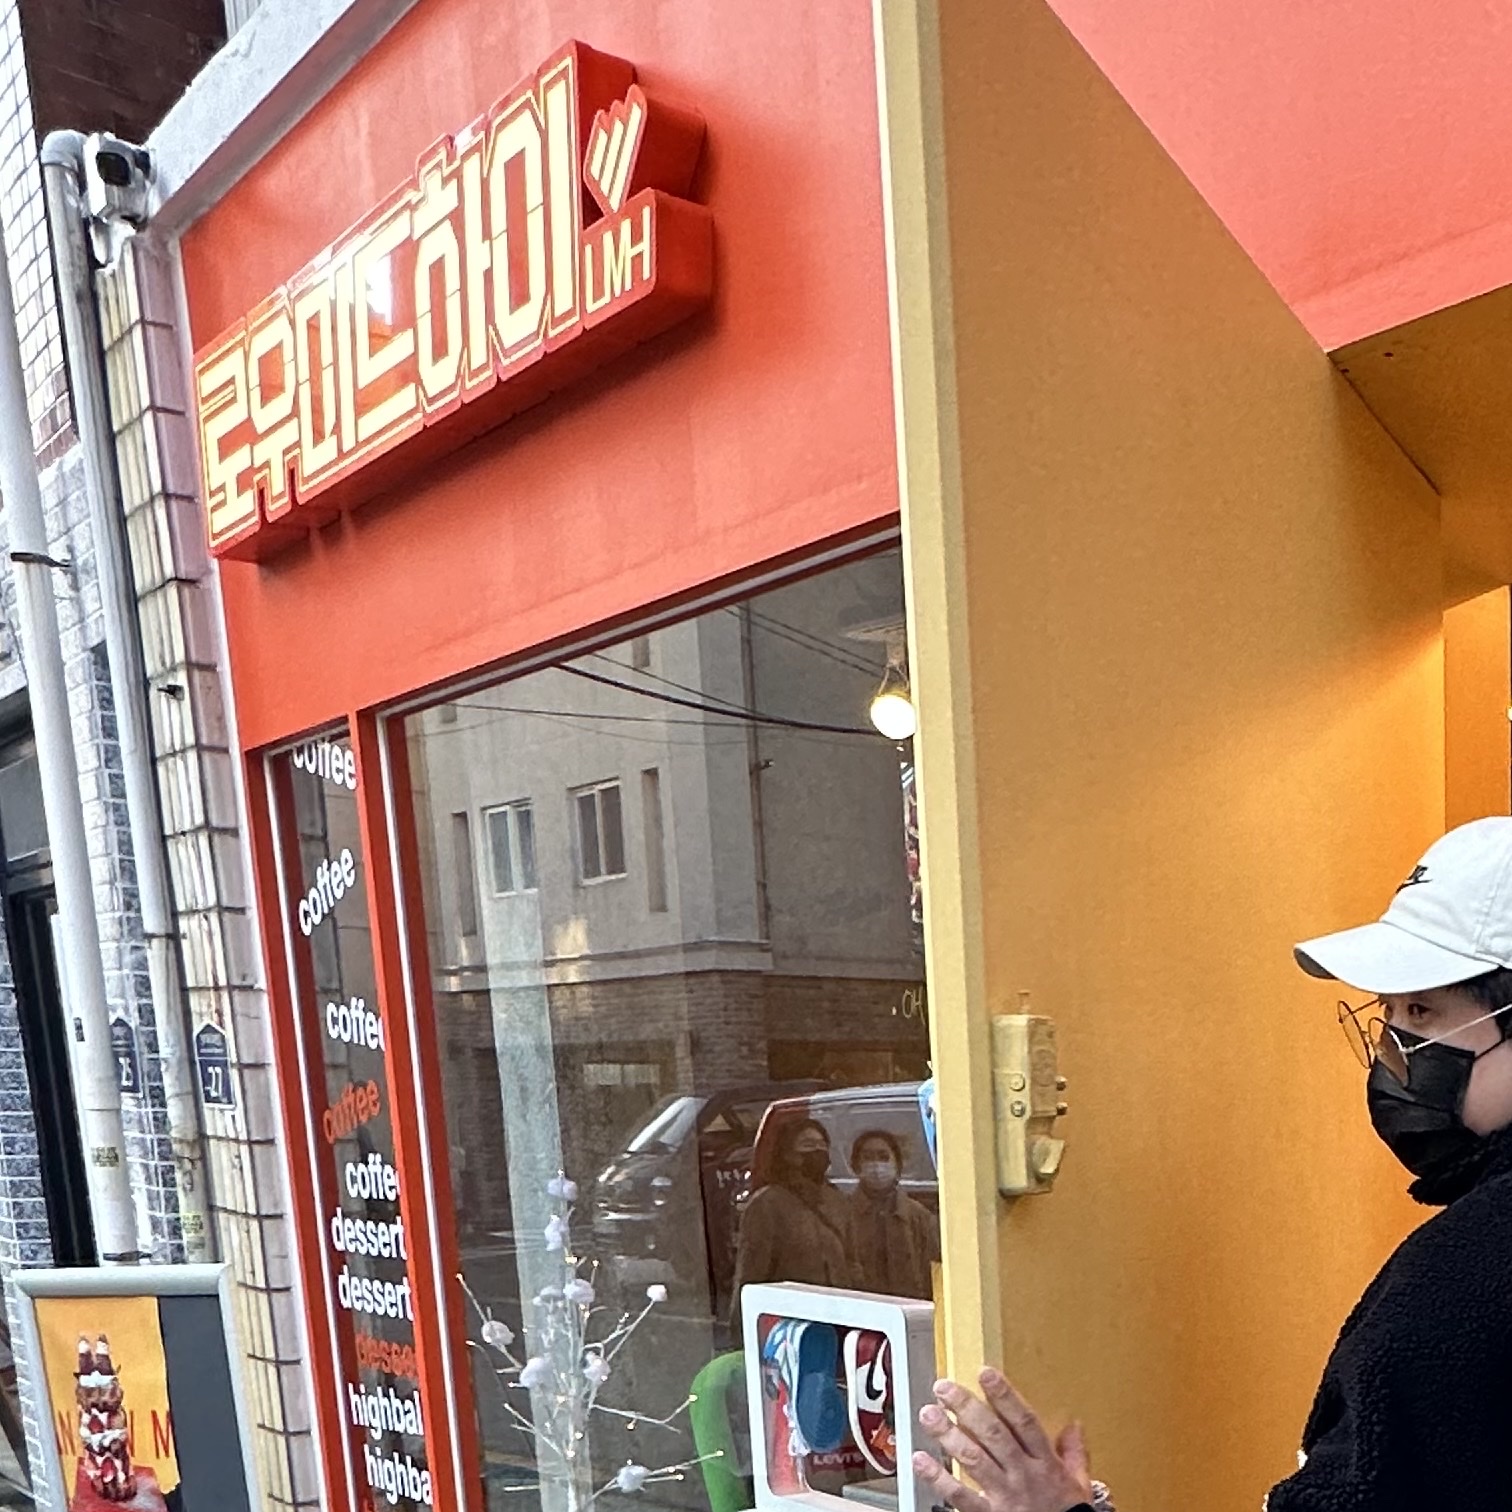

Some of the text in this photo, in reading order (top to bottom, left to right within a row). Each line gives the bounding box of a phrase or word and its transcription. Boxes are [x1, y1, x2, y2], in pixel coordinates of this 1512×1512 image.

[196, 57, 578, 545] 로우미드하이
[584, 206, 651, 314] LMH
[299, 848, 356, 936] coffee
[345, 1152, 401, 1201] coffe
